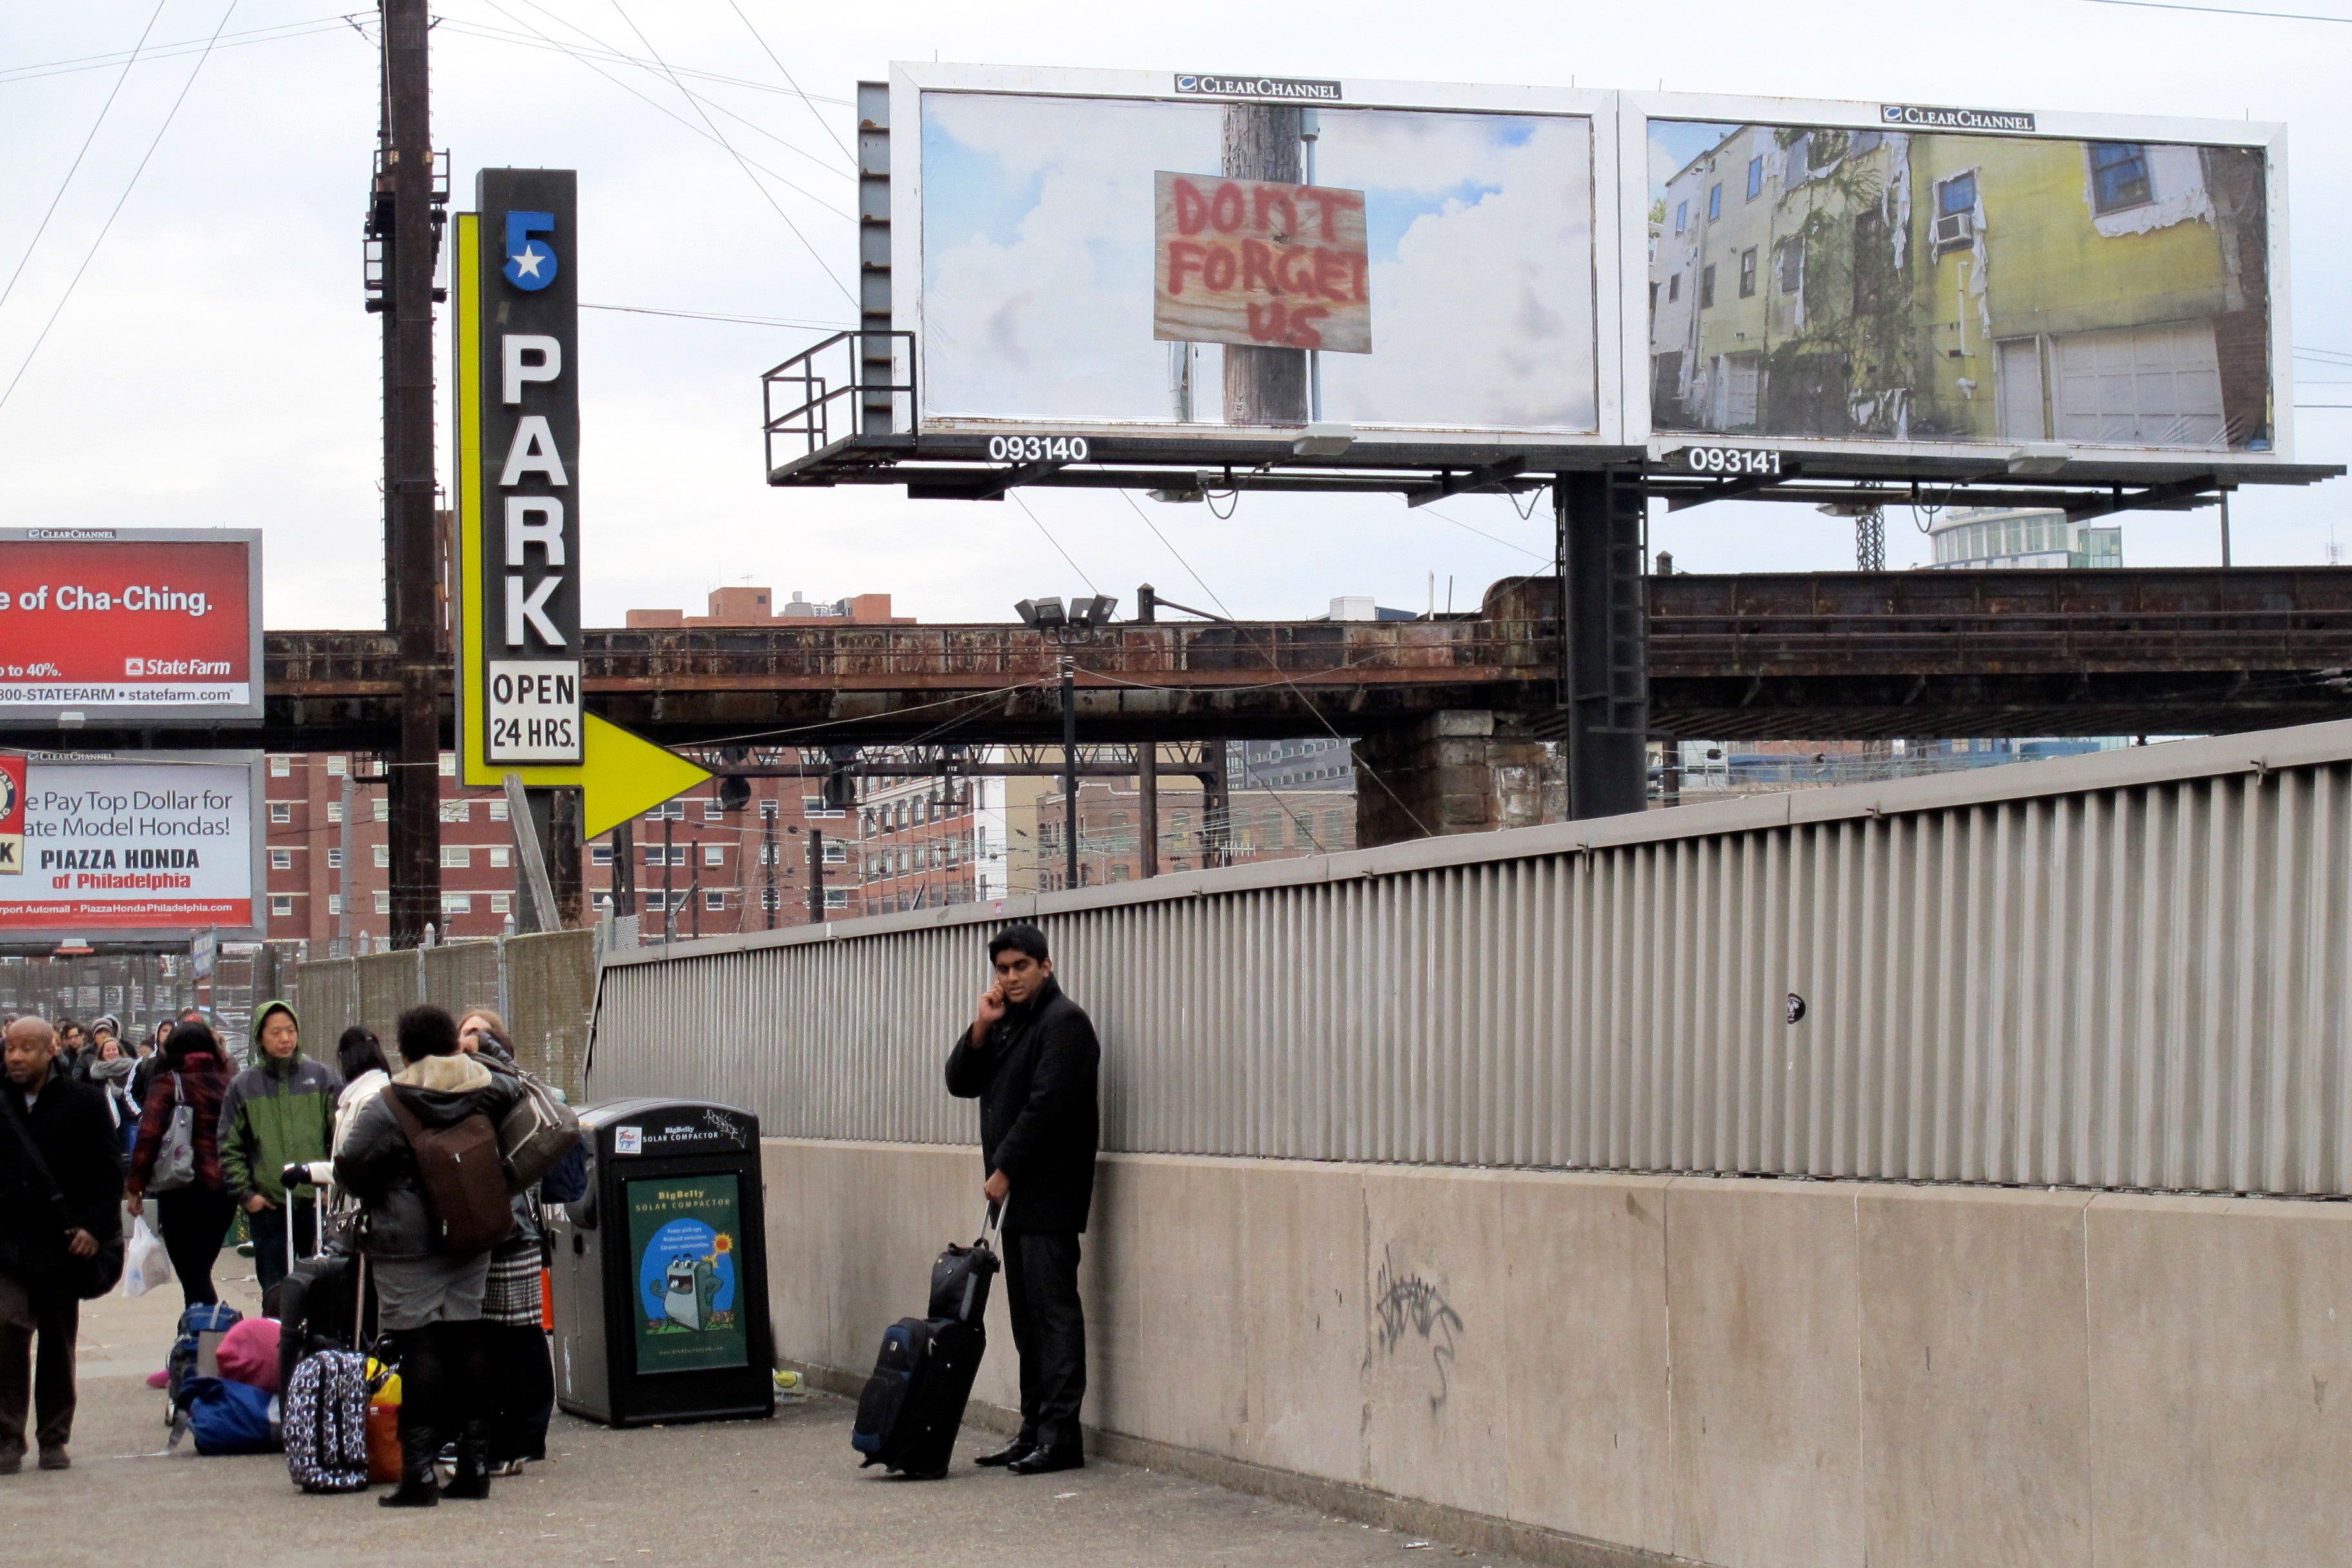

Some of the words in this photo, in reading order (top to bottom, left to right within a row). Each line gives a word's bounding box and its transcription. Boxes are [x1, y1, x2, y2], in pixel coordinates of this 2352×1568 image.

[503, 211, 558, 291] 5
[1247, 301, 1329, 349] US
[989, 436, 1088, 460] 093140
[1689, 447, 1780, 473] 093141
[499, 333, 569, 646] PARK
[19, 585, 48, 610] of
[56, 585, 213, 616] Cha-Ching.
[8, 665, 23, 676] to
[26, 663, 62, 676] 40%.
[129, 688, 231, 701] statefarm.com
[493, 674, 574, 705] OPEN
[494, 718, 522, 747] 24
[529, 718, 575, 747] HRS.
[44, 792, 83, 816] Pay
[85, 792, 128, 815] Top
[133, 790, 199, 810] Dollar
[202, 790, 233, 810] for
[24, 819, 57, 837] ate
[63, 816, 133, 836] Model
[140, 816, 230, 836] Hondas!
[41, 849, 117, 869] PIAZZA
[125, 848, 199, 869] HONDA
[52, 874, 71, 889] of
[77, 872, 191, 890] Philadelphia
[25, 905, 70, 914] Automall
[671, 1132, 719, 1141] COMPACTOR
[635, 1202, 667, 1211] SOLAR
[672, 1199, 730, 1208] COMPACTOR
[658, 1190, 705, 1200] BigBelly
